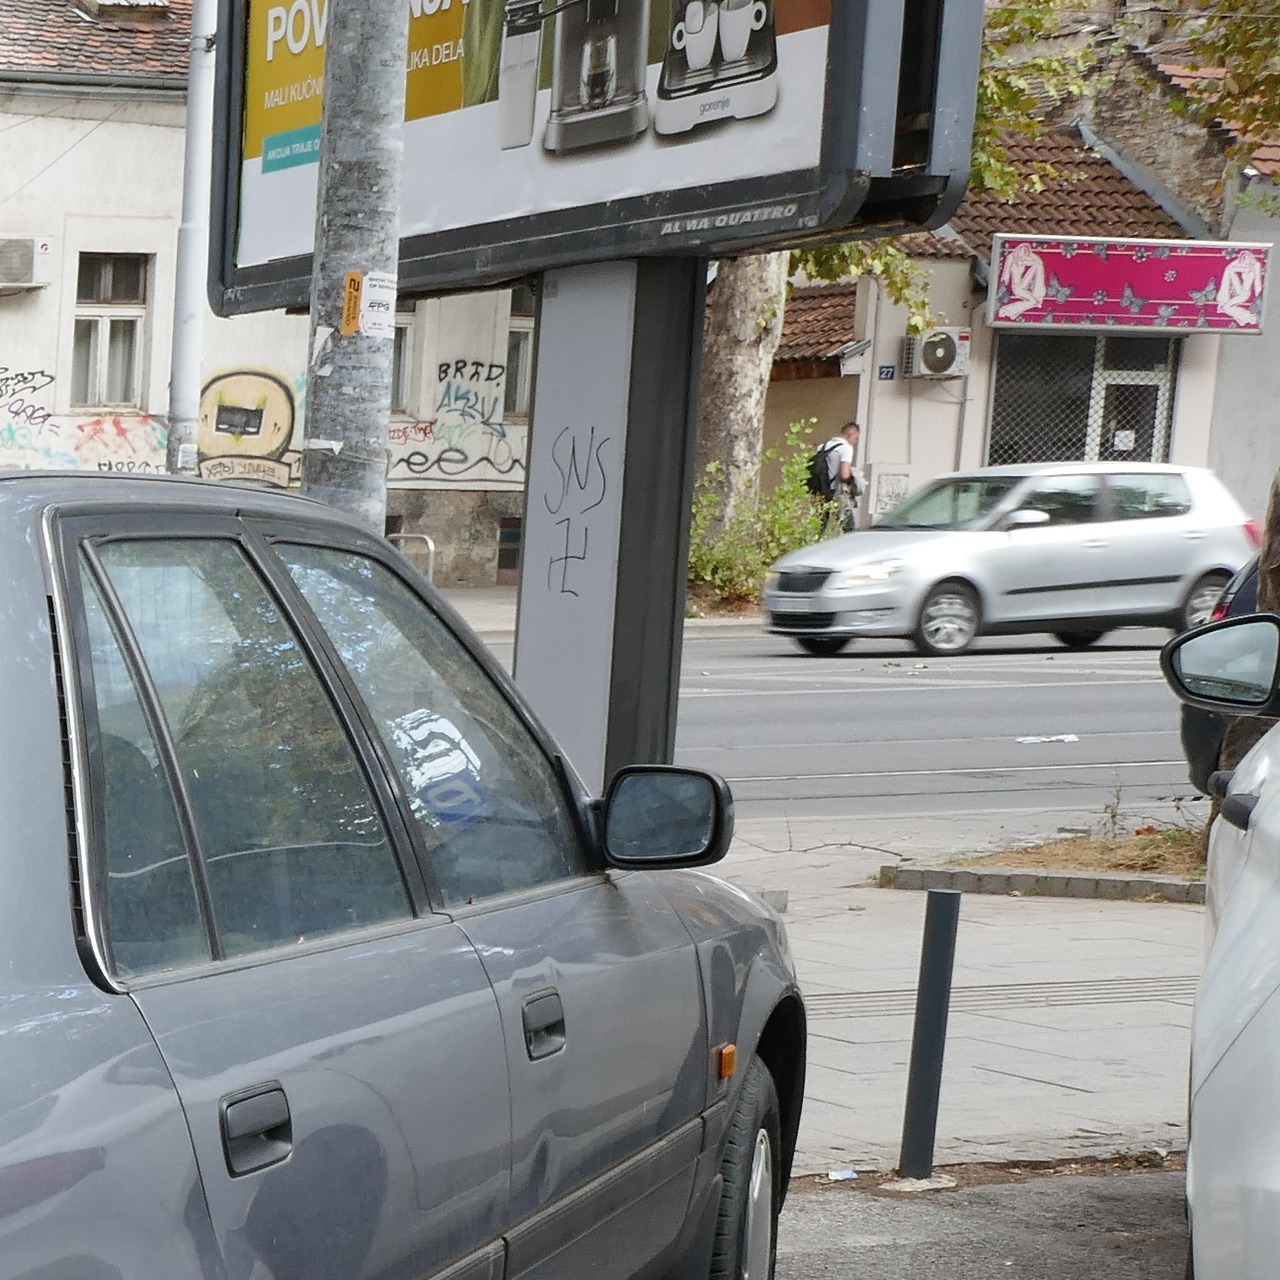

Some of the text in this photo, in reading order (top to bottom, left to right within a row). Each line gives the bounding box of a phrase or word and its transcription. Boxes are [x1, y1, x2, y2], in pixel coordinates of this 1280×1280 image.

[264, 85, 289, 109] MALI
[432, 38, 465, 65] DELA
[699, 96, 730, 115] gorenje
[291, 140, 312, 155] TRAJE
[714, 203, 799, 227] QUATTRO
[880, 367, 894, 379] 27
[543, 425, 611, 515] SNS
